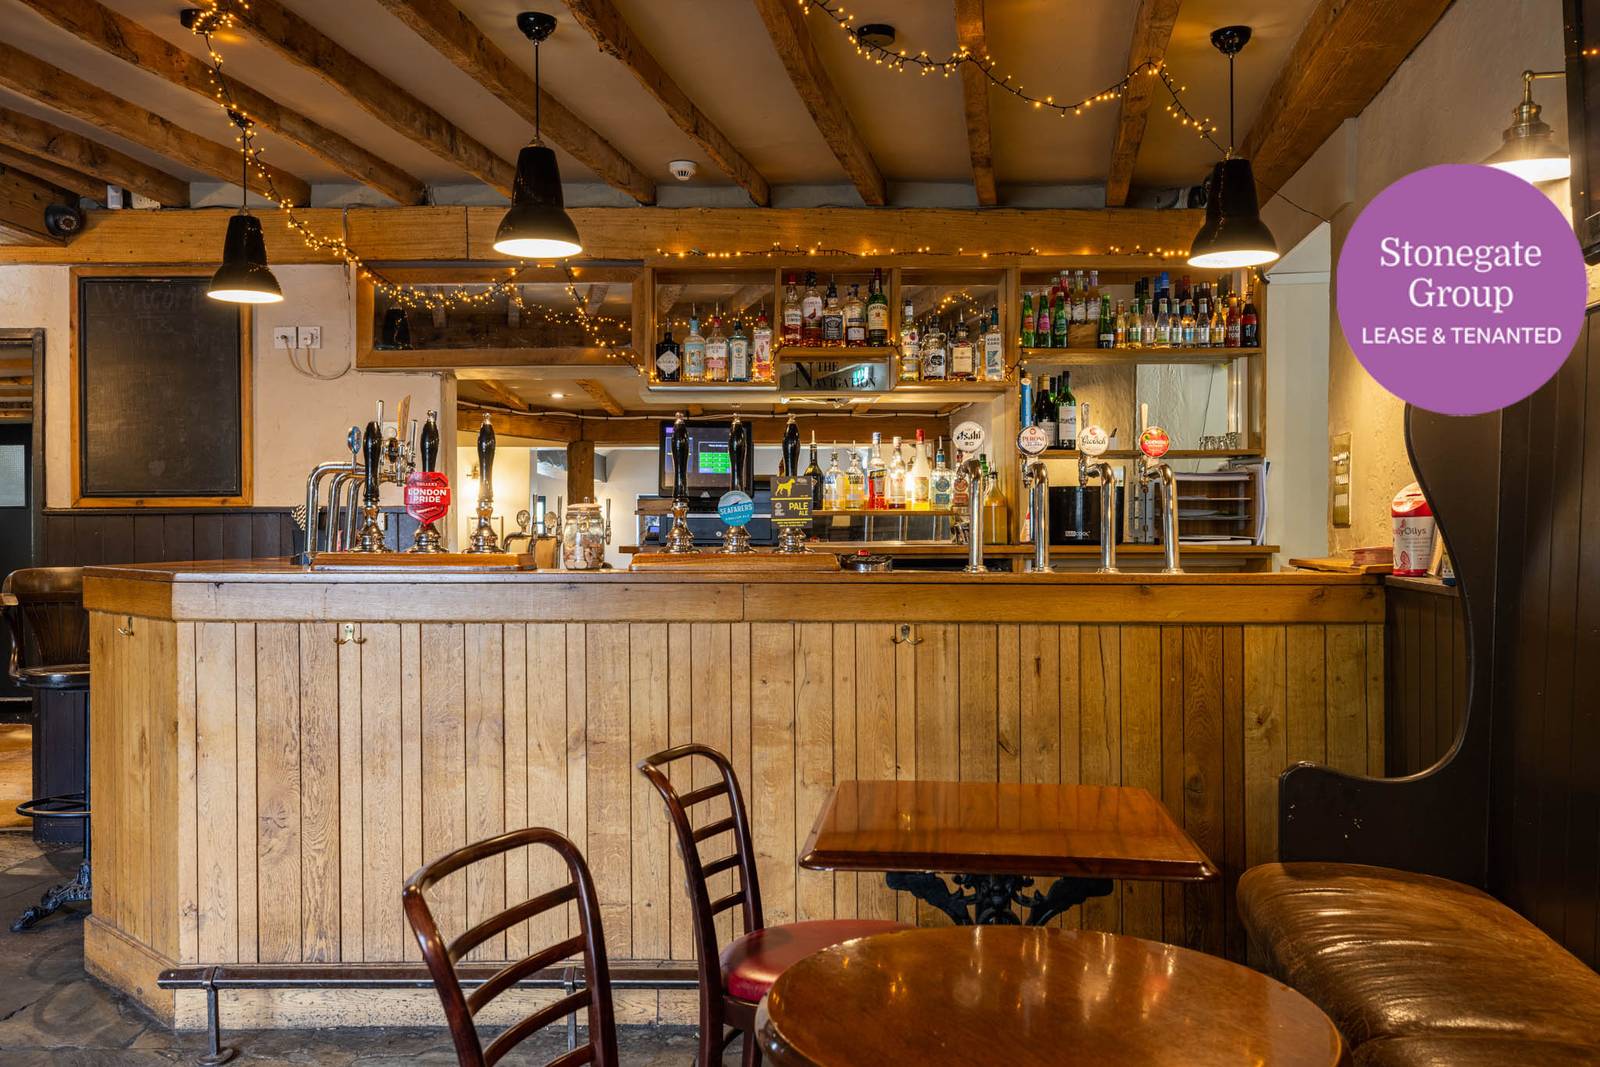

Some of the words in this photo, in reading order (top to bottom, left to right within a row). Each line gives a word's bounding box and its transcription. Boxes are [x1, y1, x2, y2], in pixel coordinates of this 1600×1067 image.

[818, 361, 839, 372] THE
[956, 430, 981, 441] Asahi
[408, 488, 447, 496] LONDON
[413, 495, 441, 503] PRIDE
[719, 503, 753, 516] SEAFARERS
[788, 502, 809, 511] PALE
